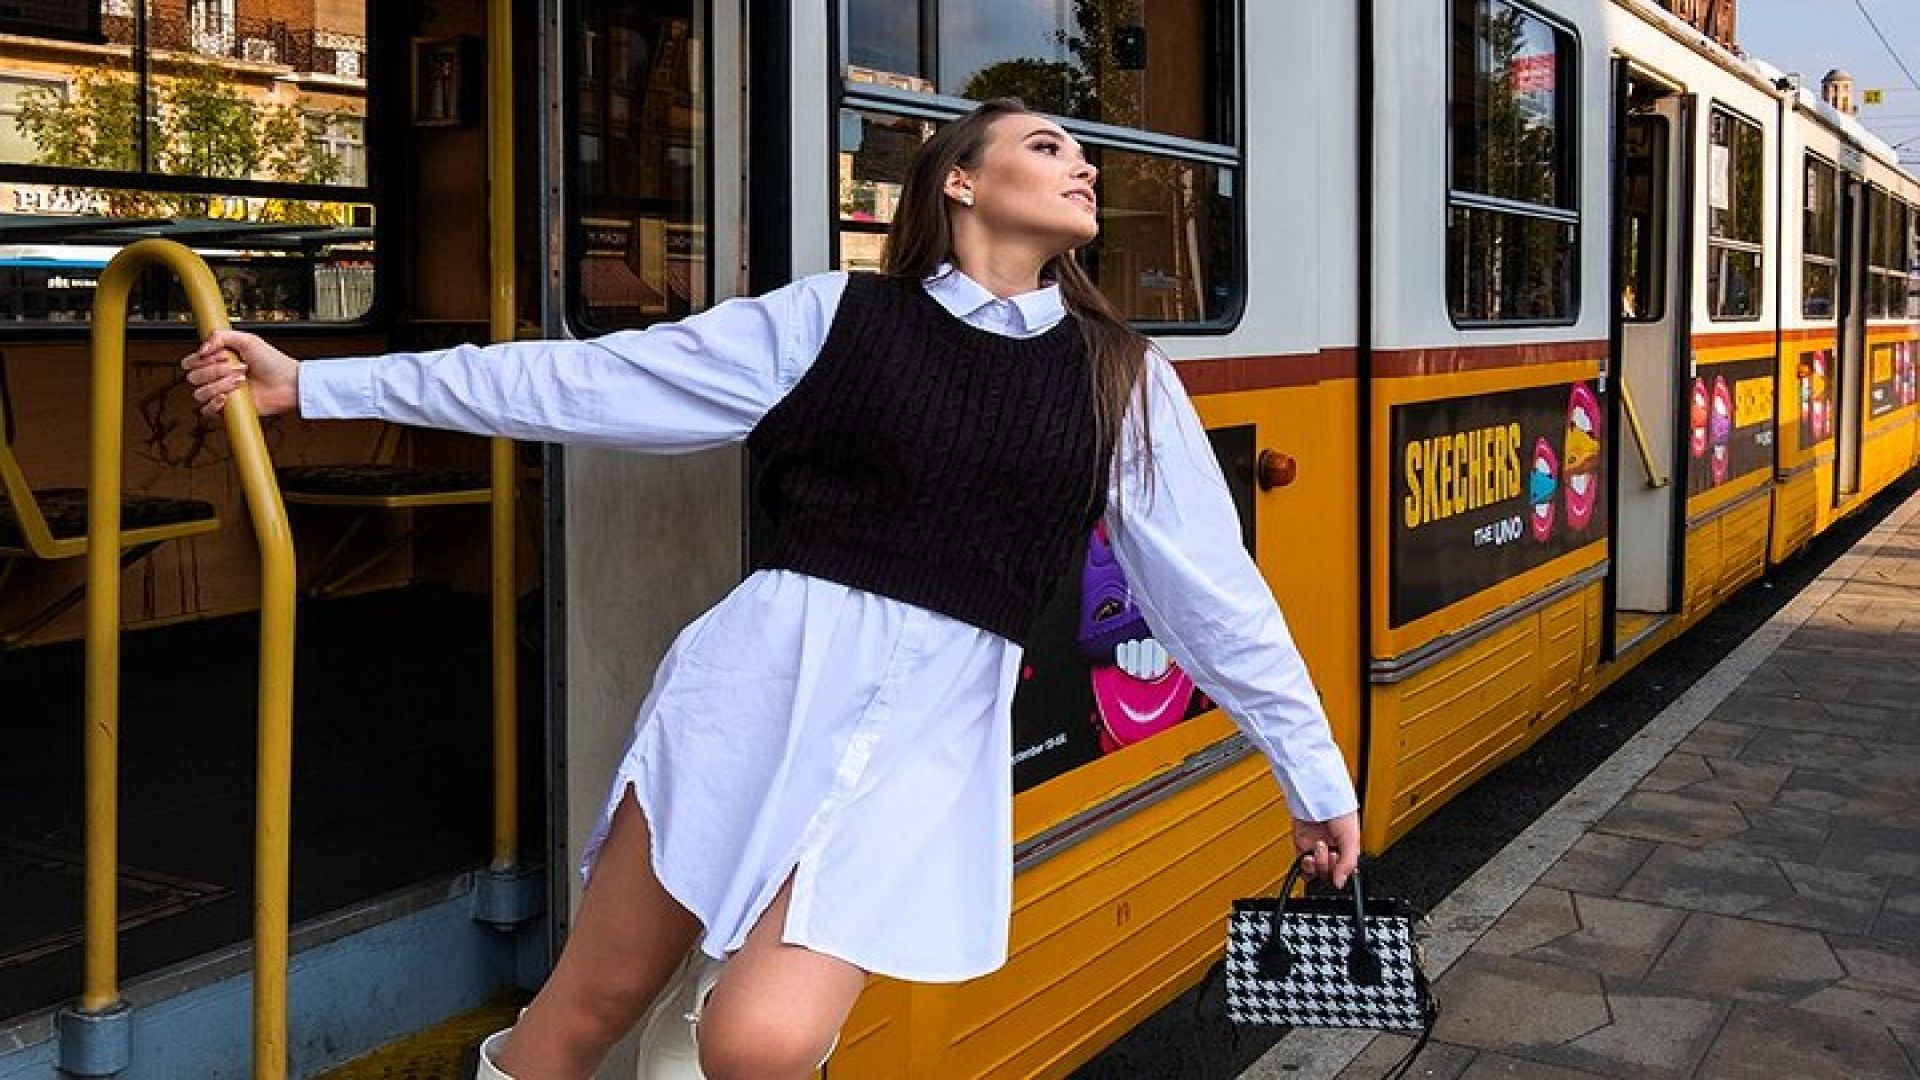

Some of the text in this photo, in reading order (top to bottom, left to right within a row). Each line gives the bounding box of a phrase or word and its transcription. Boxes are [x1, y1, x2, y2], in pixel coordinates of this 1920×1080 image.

[1405, 422, 1521, 528] SKECHERS
[1474, 514, 1524, 547] THE UNO
